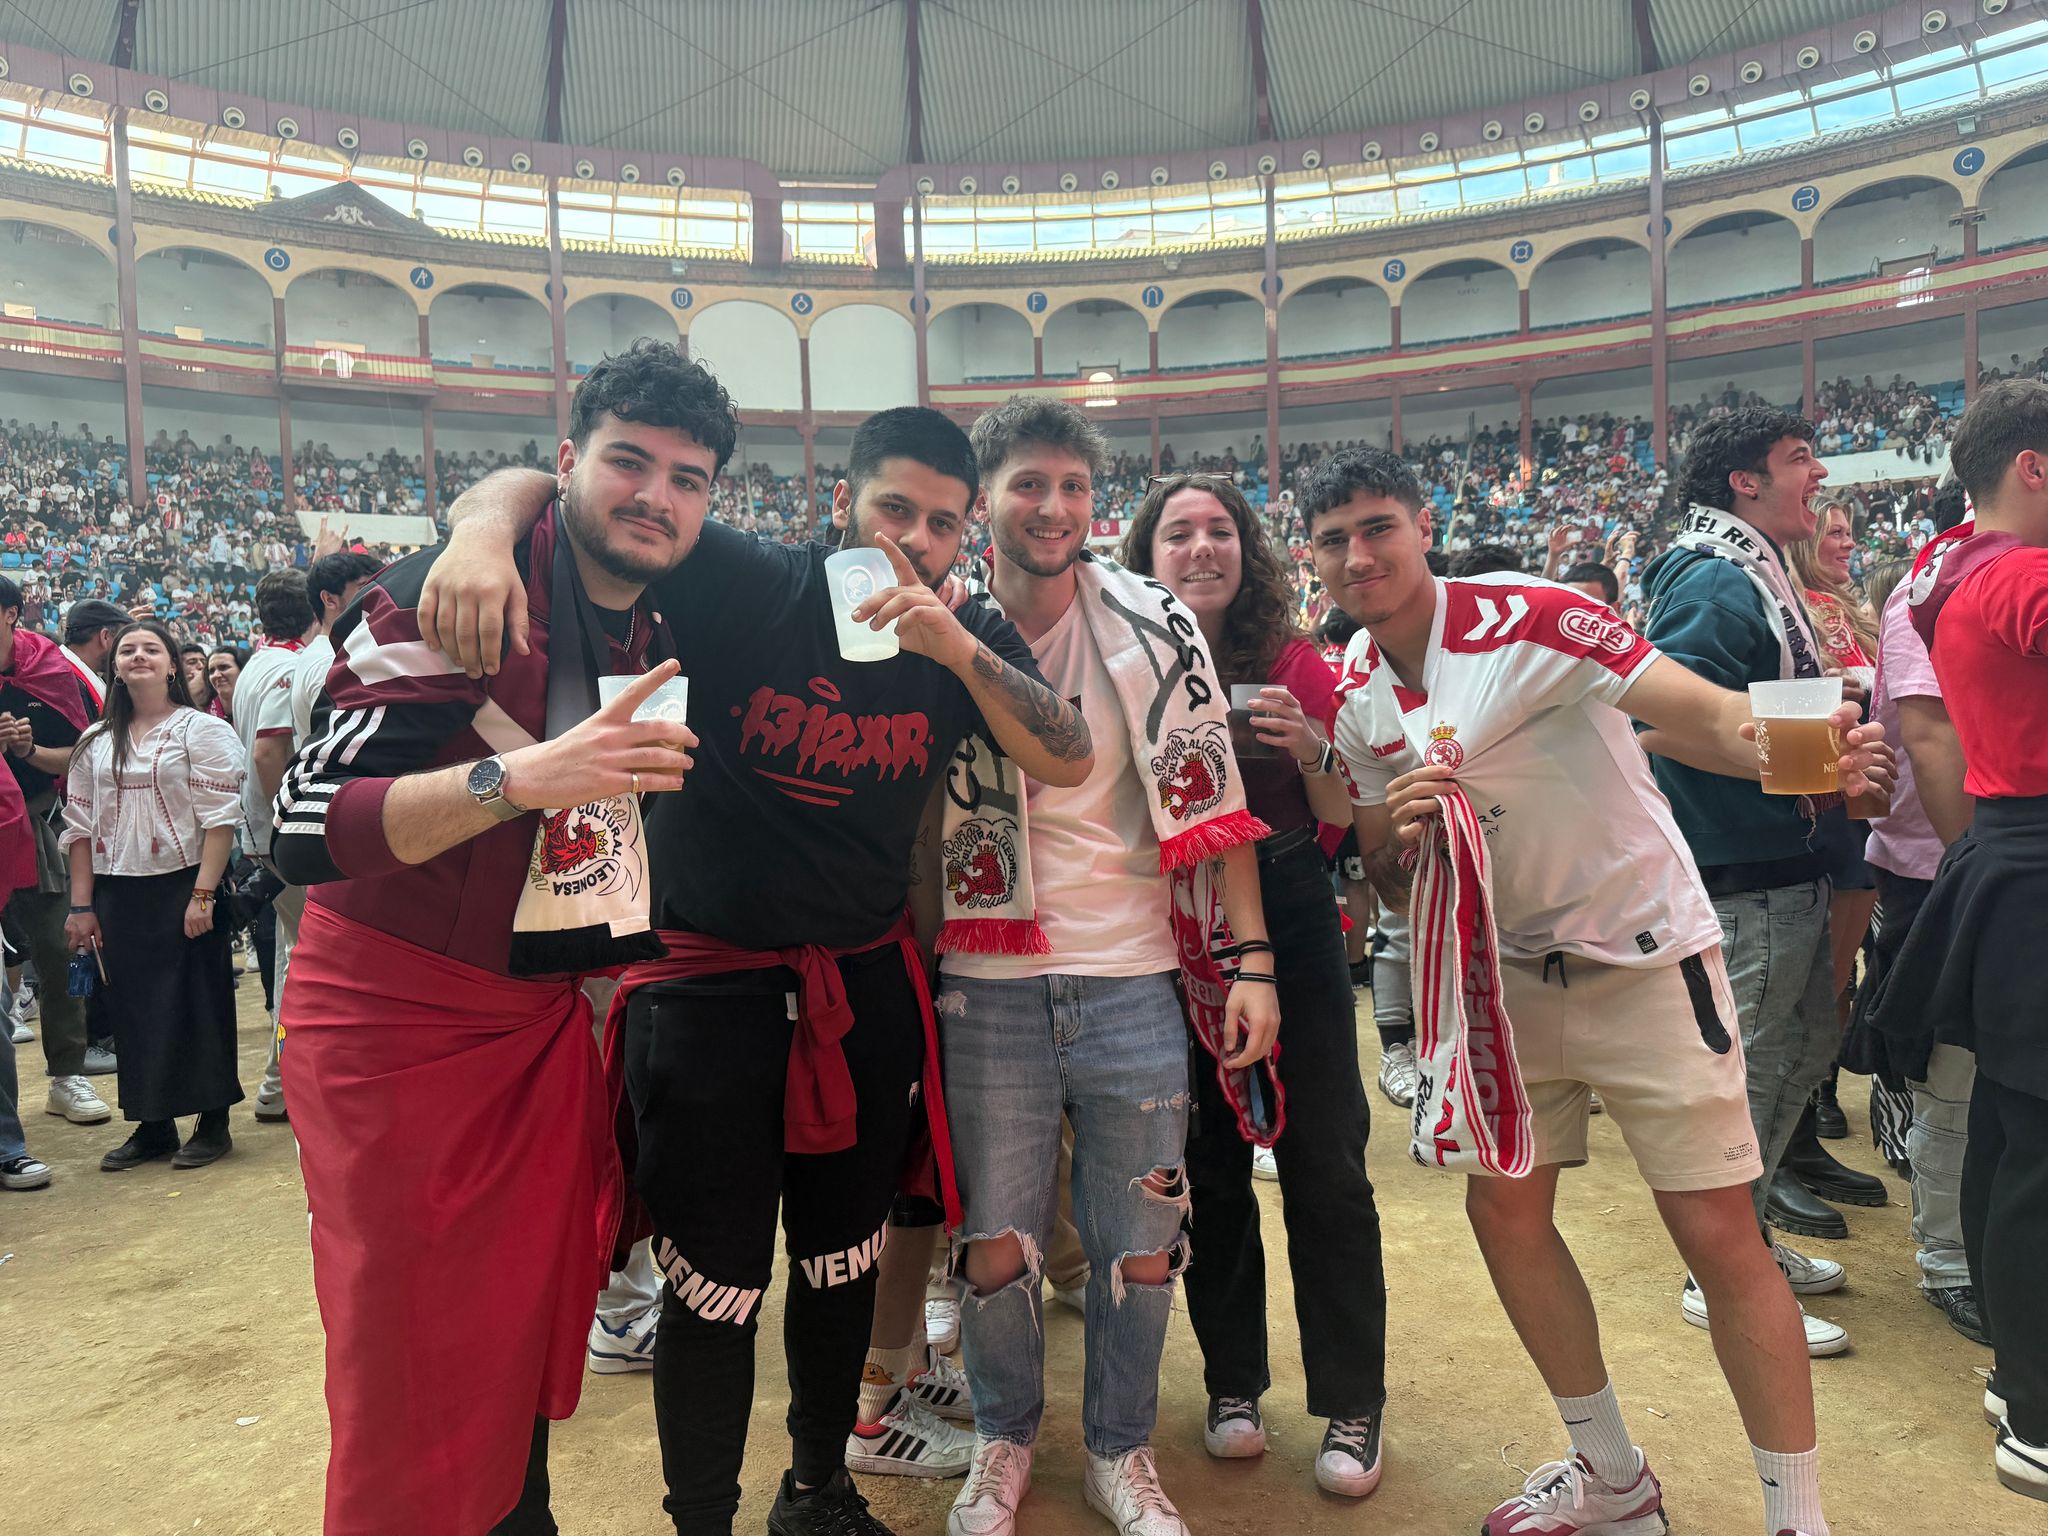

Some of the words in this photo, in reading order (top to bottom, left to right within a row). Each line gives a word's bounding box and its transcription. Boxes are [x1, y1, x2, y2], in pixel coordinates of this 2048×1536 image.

[1720, 525, 1770, 562] REY
[1143, 579, 1212, 712] nesa
[1167, 738, 1202, 781] CULTURAL
[1204, 743, 1227, 790] LEONESA
[577, 803, 623, 857] CULTURAL
[1478, 804, 1507, 824] RE
[1484, 824, 1500, 837] MY
[552, 861, 616, 896] LEONESA
[960, 830, 1000, 868] CULTURAL
[1001, 841, 1017, 890] LEONESA
[657, 1235, 762, 1326] VENUM
